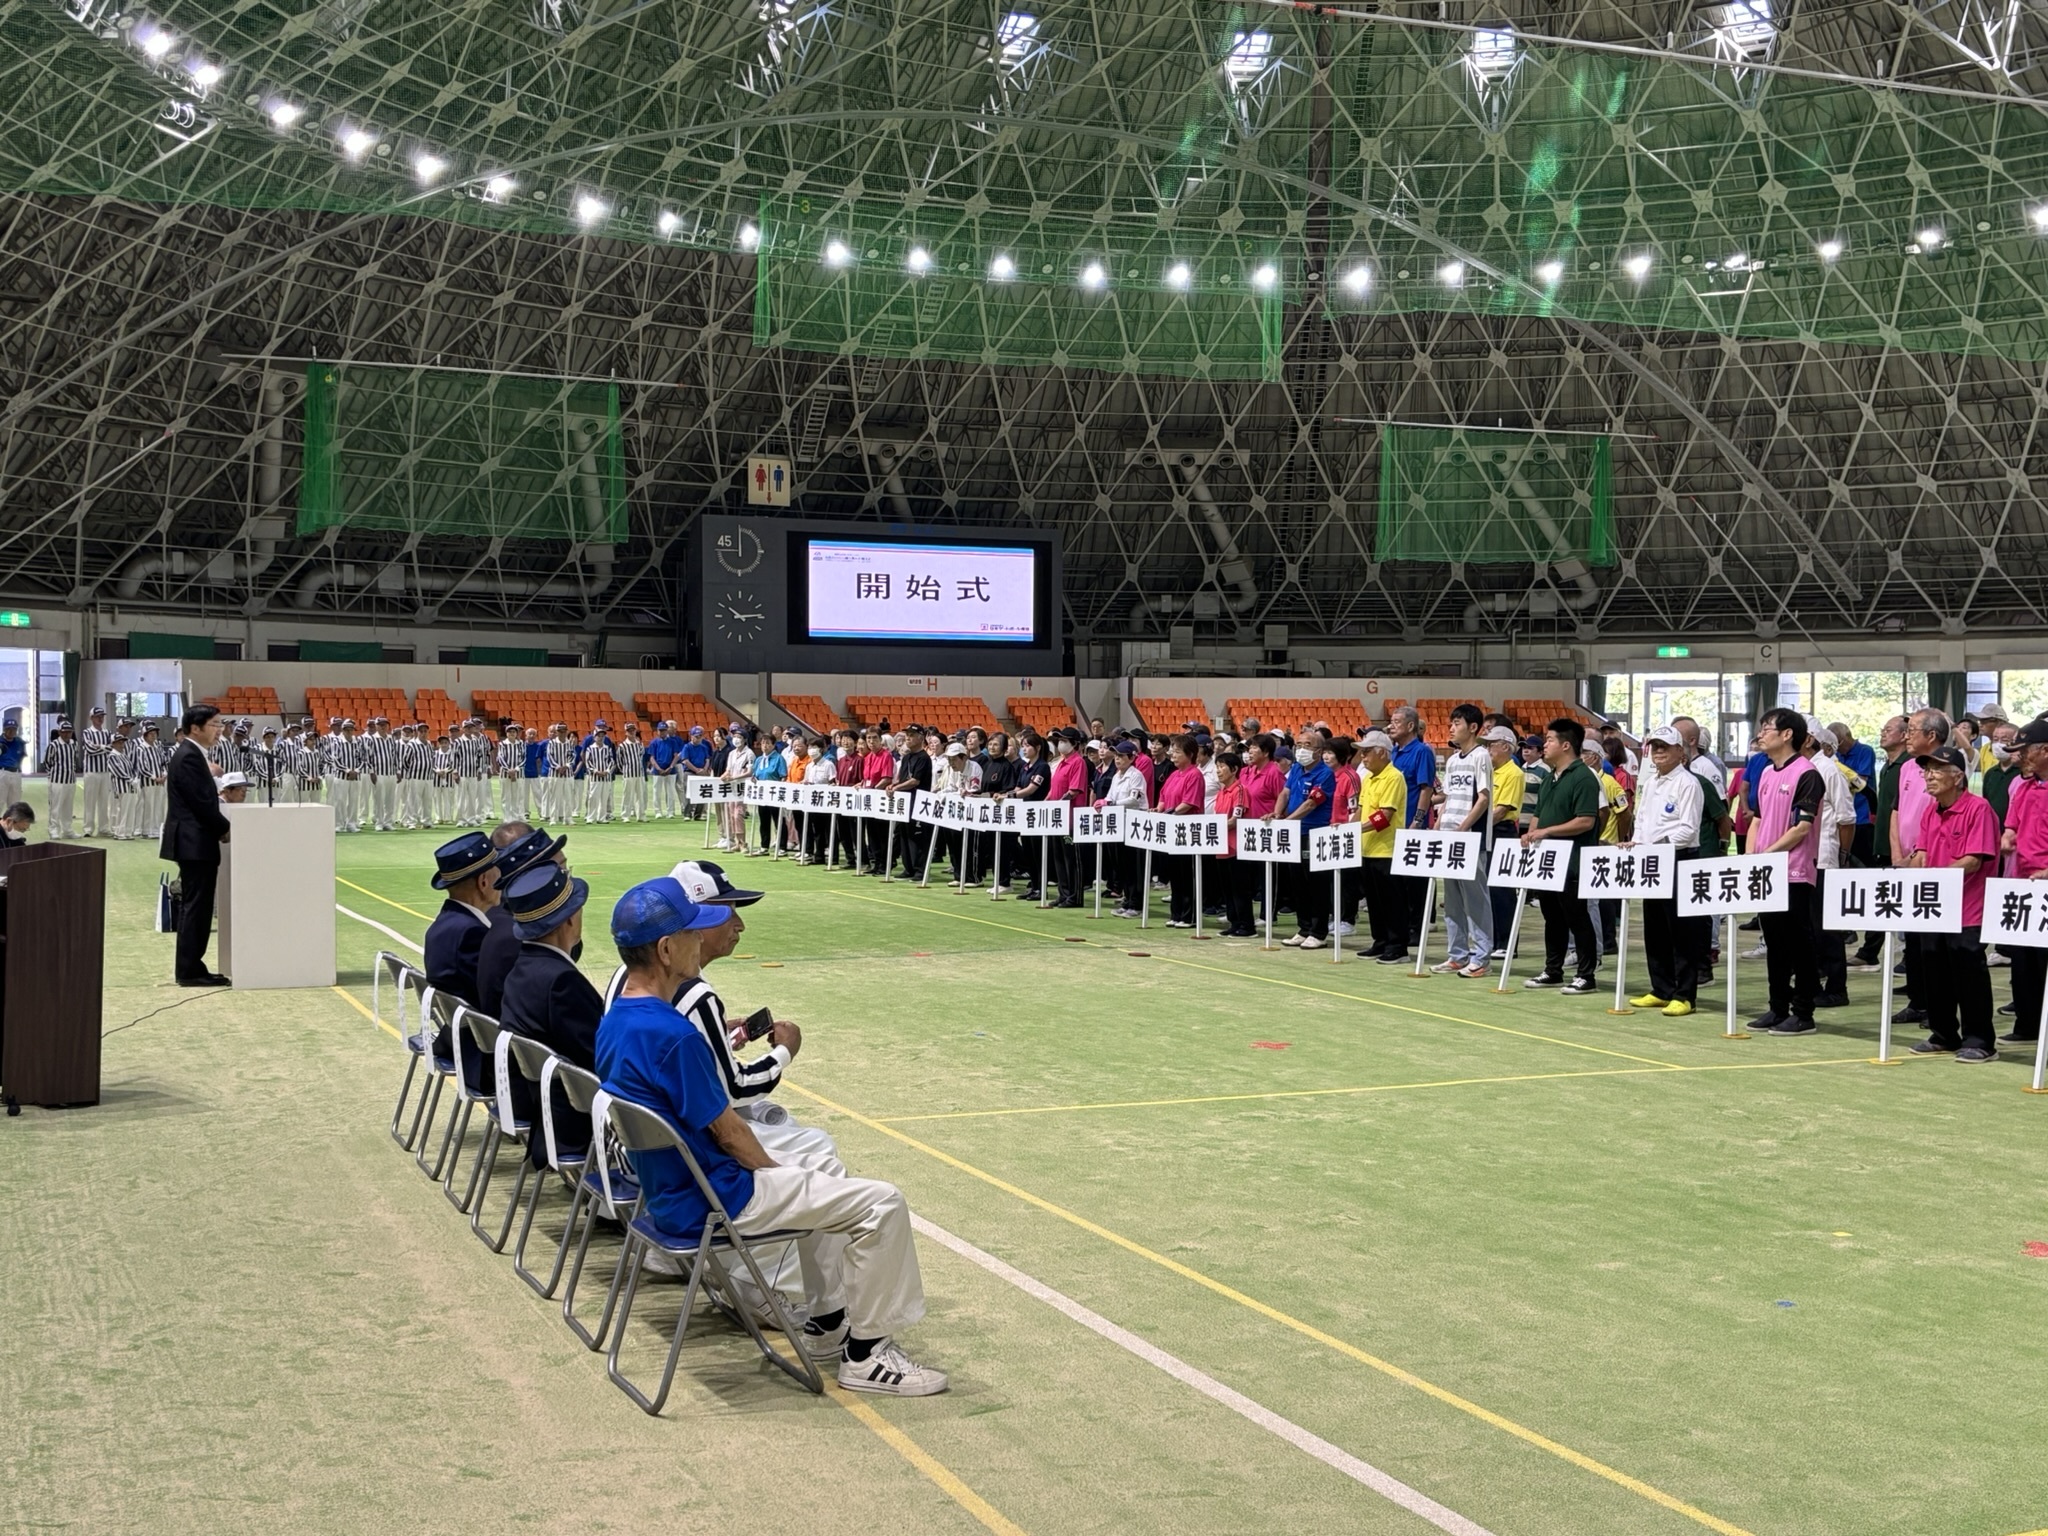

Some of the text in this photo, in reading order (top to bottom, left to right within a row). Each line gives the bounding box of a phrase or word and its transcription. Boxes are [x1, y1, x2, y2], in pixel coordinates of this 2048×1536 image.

[717, 535, 732, 547] 45
[856, 572, 991, 603] 開始式
[1760, 644, 1772, 659] C
[927, 677, 938, 692] H
[1366, 680, 1378, 695] G
[791, 788, 804, 805] 東
[845, 793, 872, 812] 石川県
[879, 796, 905, 816] 三重県
[1349, 798, 1356, 807] 1
[979, 803, 1016, 825] 広島県
[1025, 807, 1063, 829] 香川県
[1234, 808, 1242, 816] 3
[1079, 813, 1117, 836] 福岡県
[1130, 817, 1167, 845] 大分県
[1175, 822, 1220, 847] 滋賀県
[1243, 827, 1292, 854] 滋賀県
[1316, 831, 1355, 862] 北海道
[1402, 838, 1466, 870] 岩手県
[1497, 847, 1557, 881] 山形県
[1590, 854, 1661, 888] 茨城県
[1690, 865, 1774, 904] 東京都
[1841, 880, 1942, 920] 山梨県
[2000, 890, 2048, 933] 新
